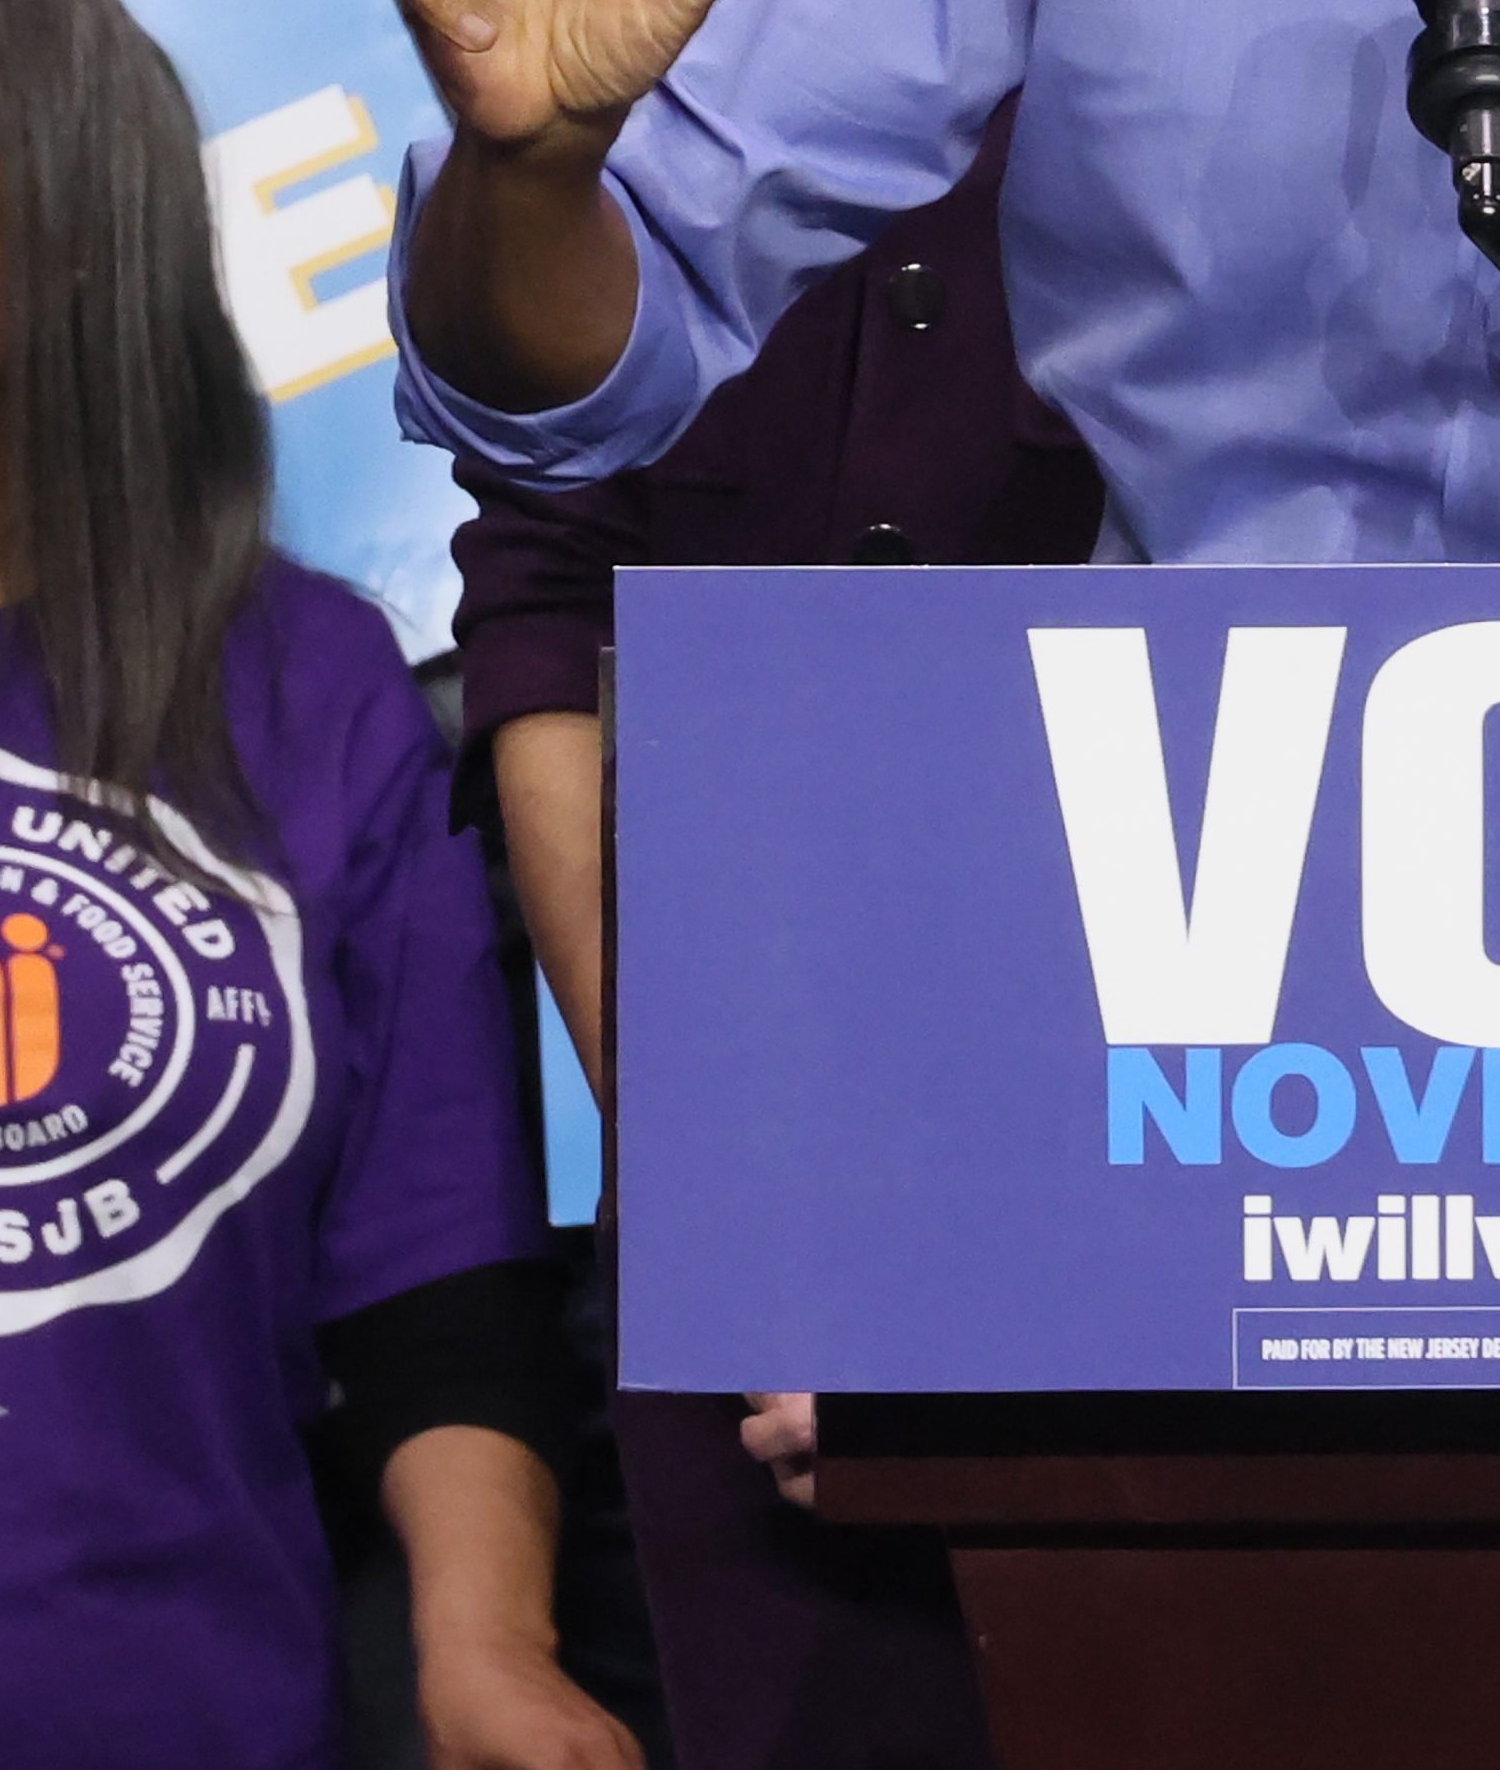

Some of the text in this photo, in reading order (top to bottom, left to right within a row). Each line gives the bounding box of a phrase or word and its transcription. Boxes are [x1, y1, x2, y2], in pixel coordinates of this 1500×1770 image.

[11, 806, 236, 960] UNITED
[30, 878, 59, 905] &
[61, 893, 137, 960] FOOD
[109, 963, 163, 1087] SERVICE
[1261, 1338, 1299, 1360] PAID
[1300, 1338, 1331, 1360] FOR
[1332, 1338, 1354, 1360] BY
[1356, 1338, 1386, 1360] THE
[1387, 1338, 1424, 1360] NEW
[1425, 1338, 1480, 1360] JERSEY
